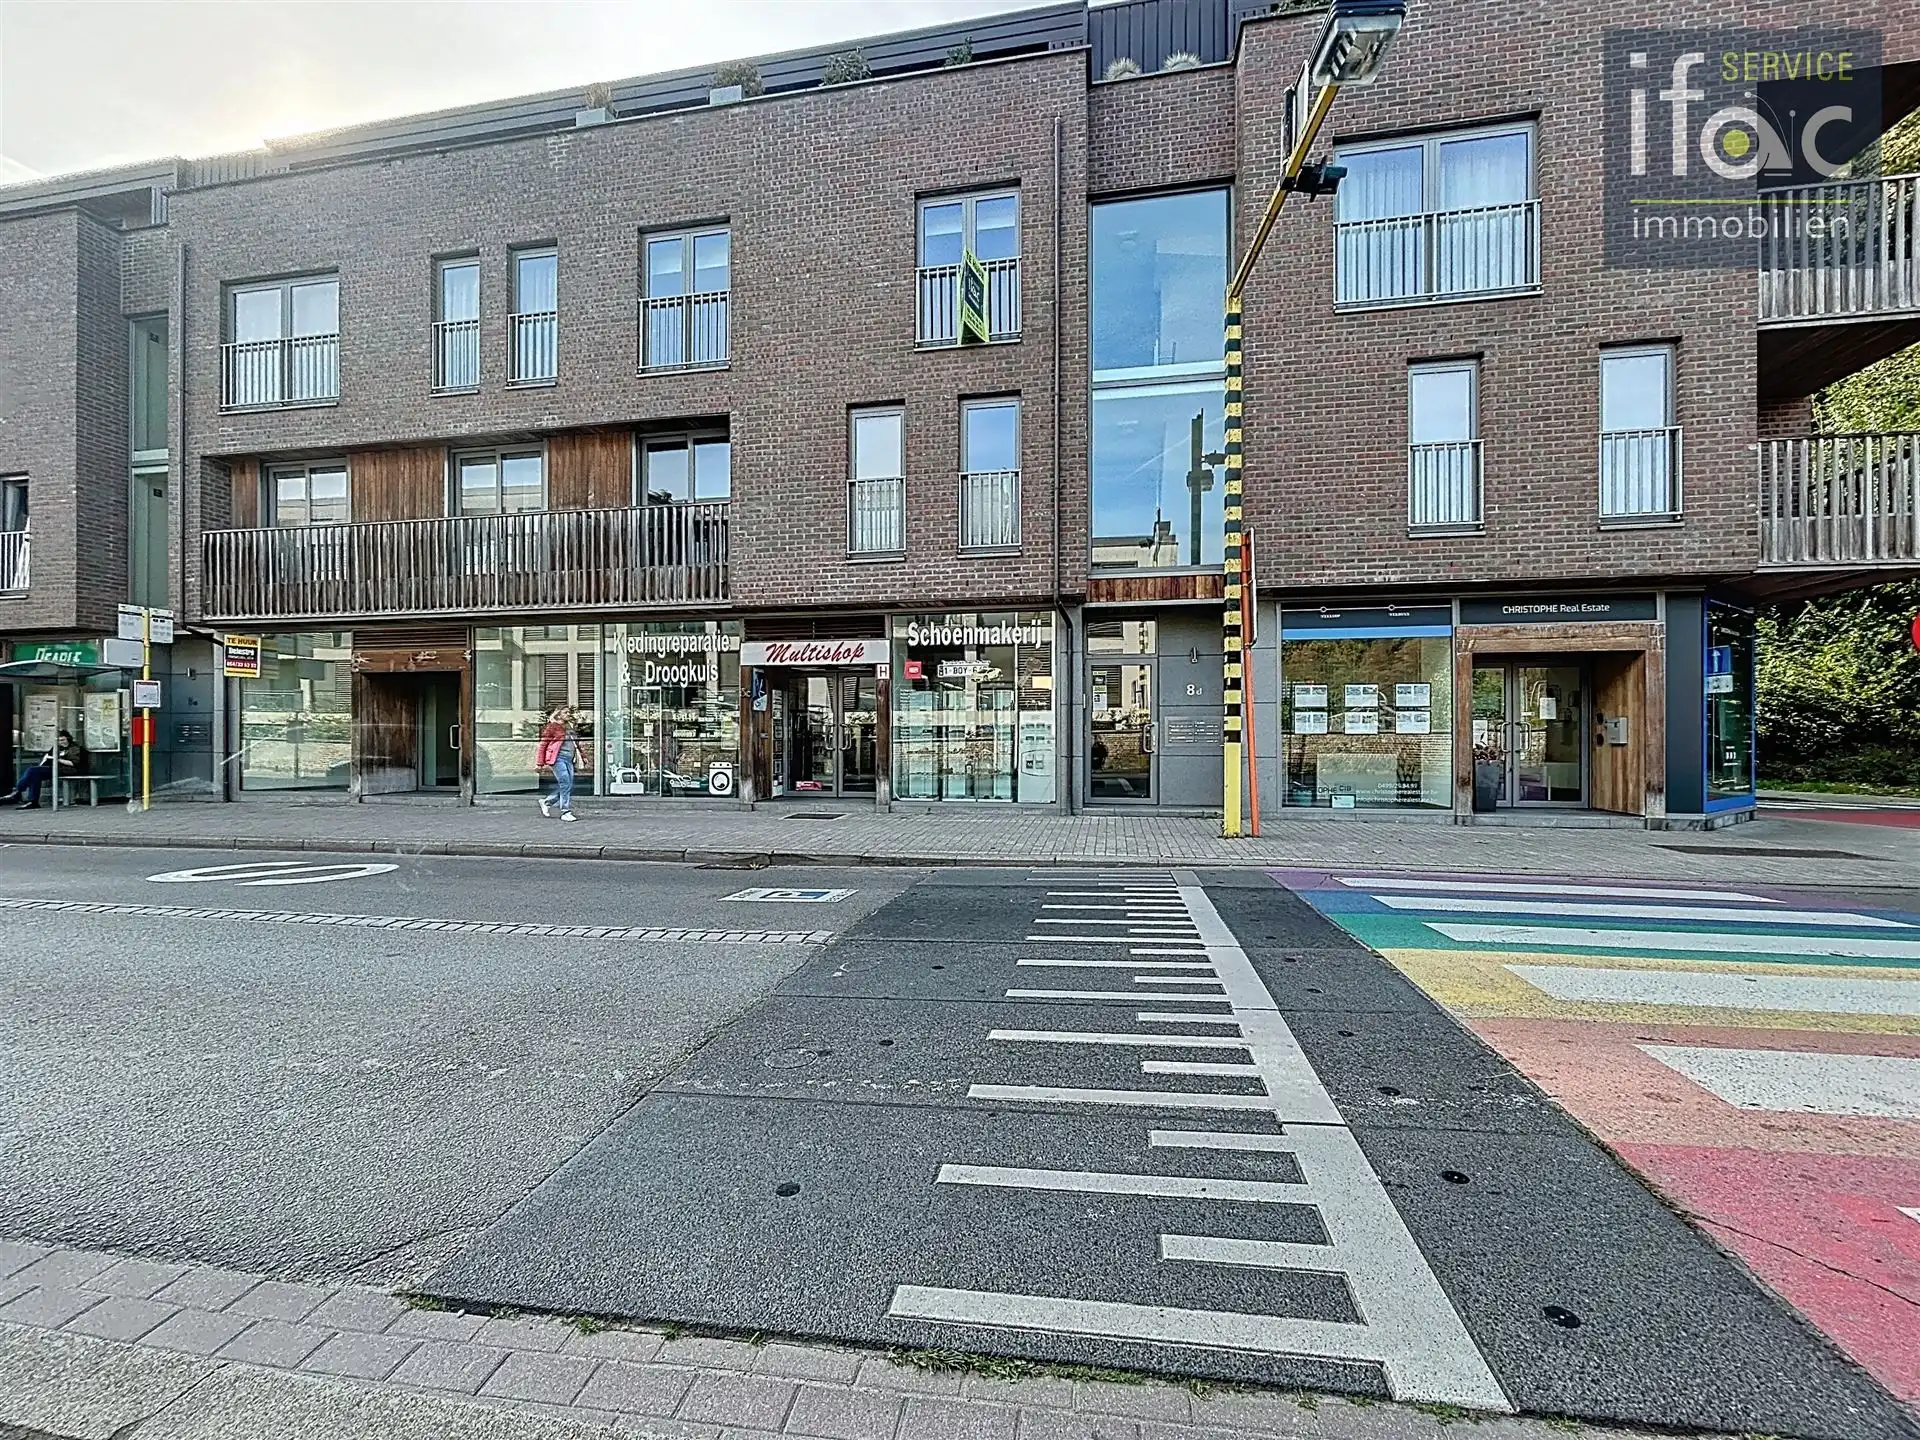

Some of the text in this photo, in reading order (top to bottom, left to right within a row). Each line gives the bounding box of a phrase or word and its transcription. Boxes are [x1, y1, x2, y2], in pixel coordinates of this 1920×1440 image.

[1502, 603, 1610, 614] CHRISTOPHE Real Estate
[613, 631, 730, 658] Kledingreparatie
[908, 620, 1042, 650] Schoenmakerij
[765, 642, 865, 663] Multishop
[621, 659, 719, 688] & Droogkuis
[879, 666, 888, 678] H
[1186, 684, 1202, 696] 8d
